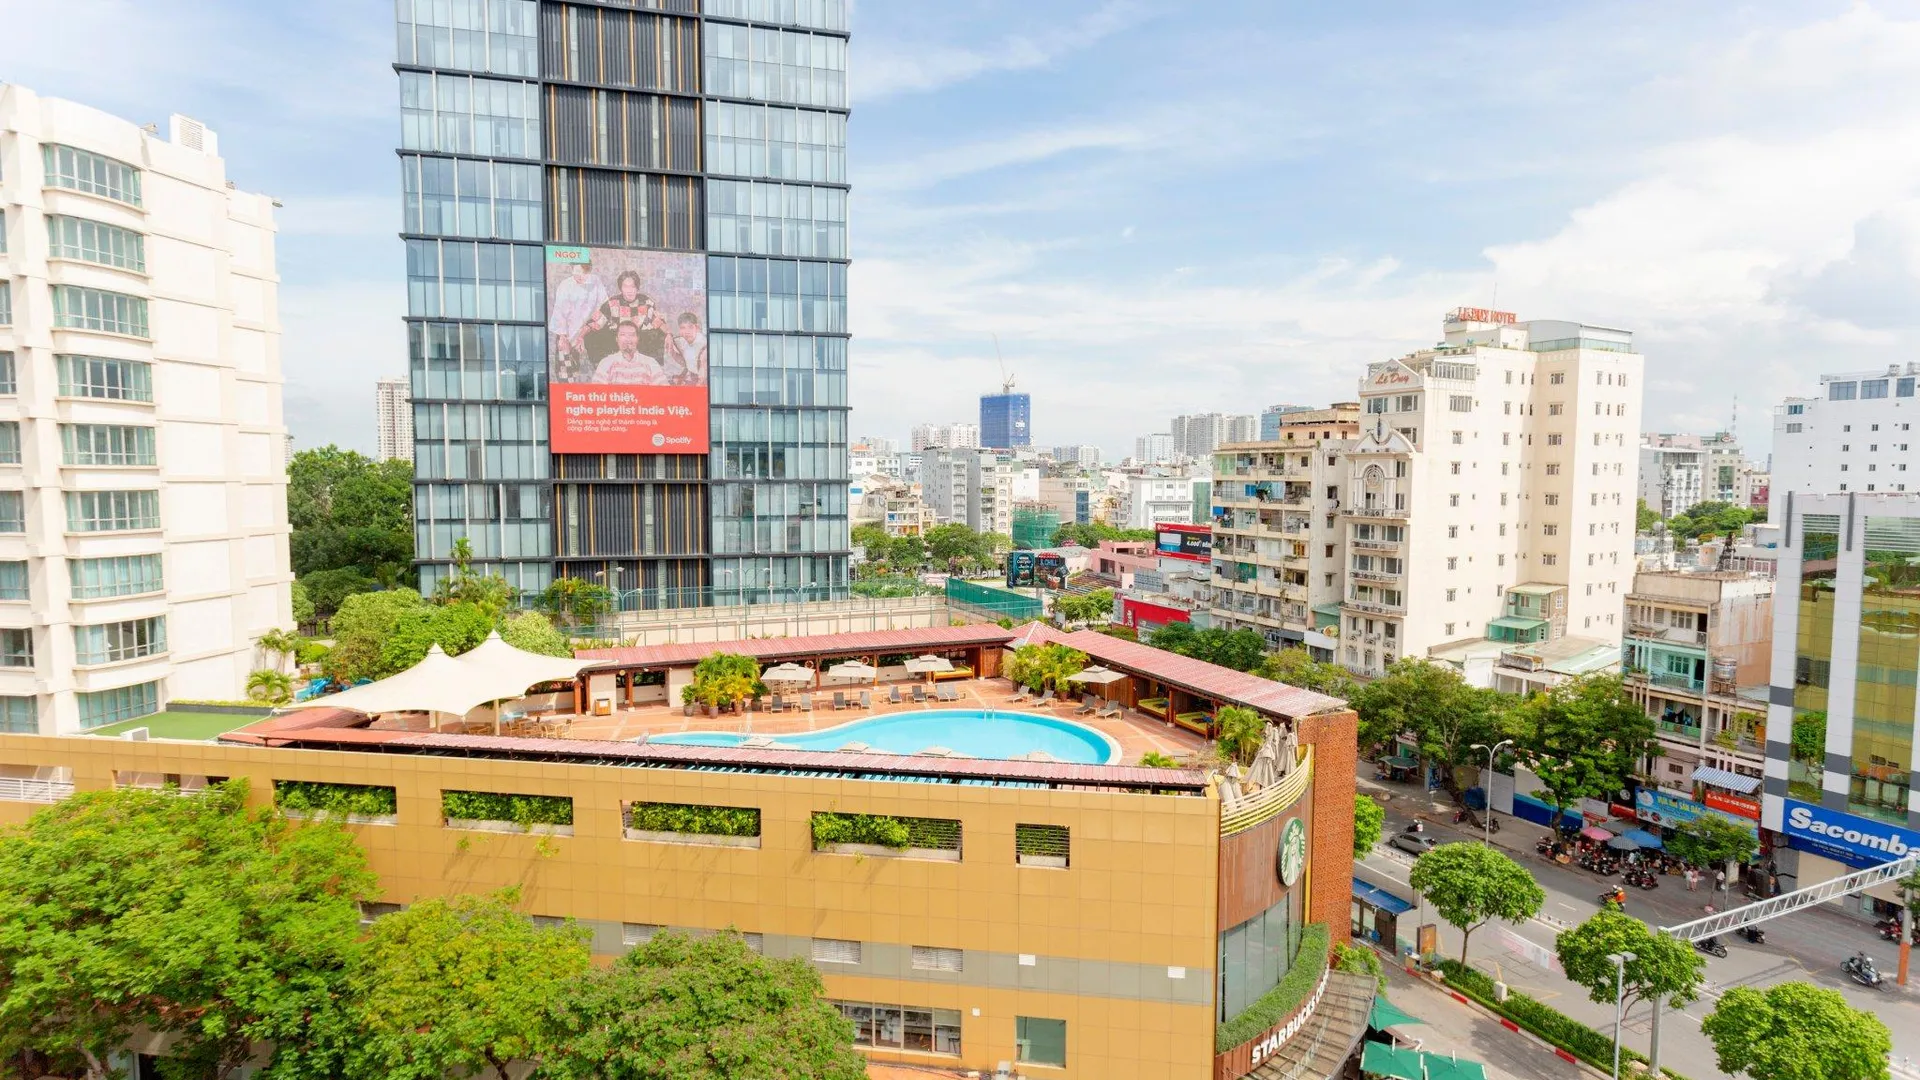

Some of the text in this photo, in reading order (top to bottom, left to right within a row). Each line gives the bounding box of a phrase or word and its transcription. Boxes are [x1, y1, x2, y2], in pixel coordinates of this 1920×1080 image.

[1490, 310, 1518, 324] HOTEL
[565, 391, 638, 404] Fan thứ thiệt,
[565, 404, 693, 418] nghe playlist Indie Việt.
[665, 436, 692, 445] Spotify
[1251, 995, 1316, 1064] STARBUCKS
